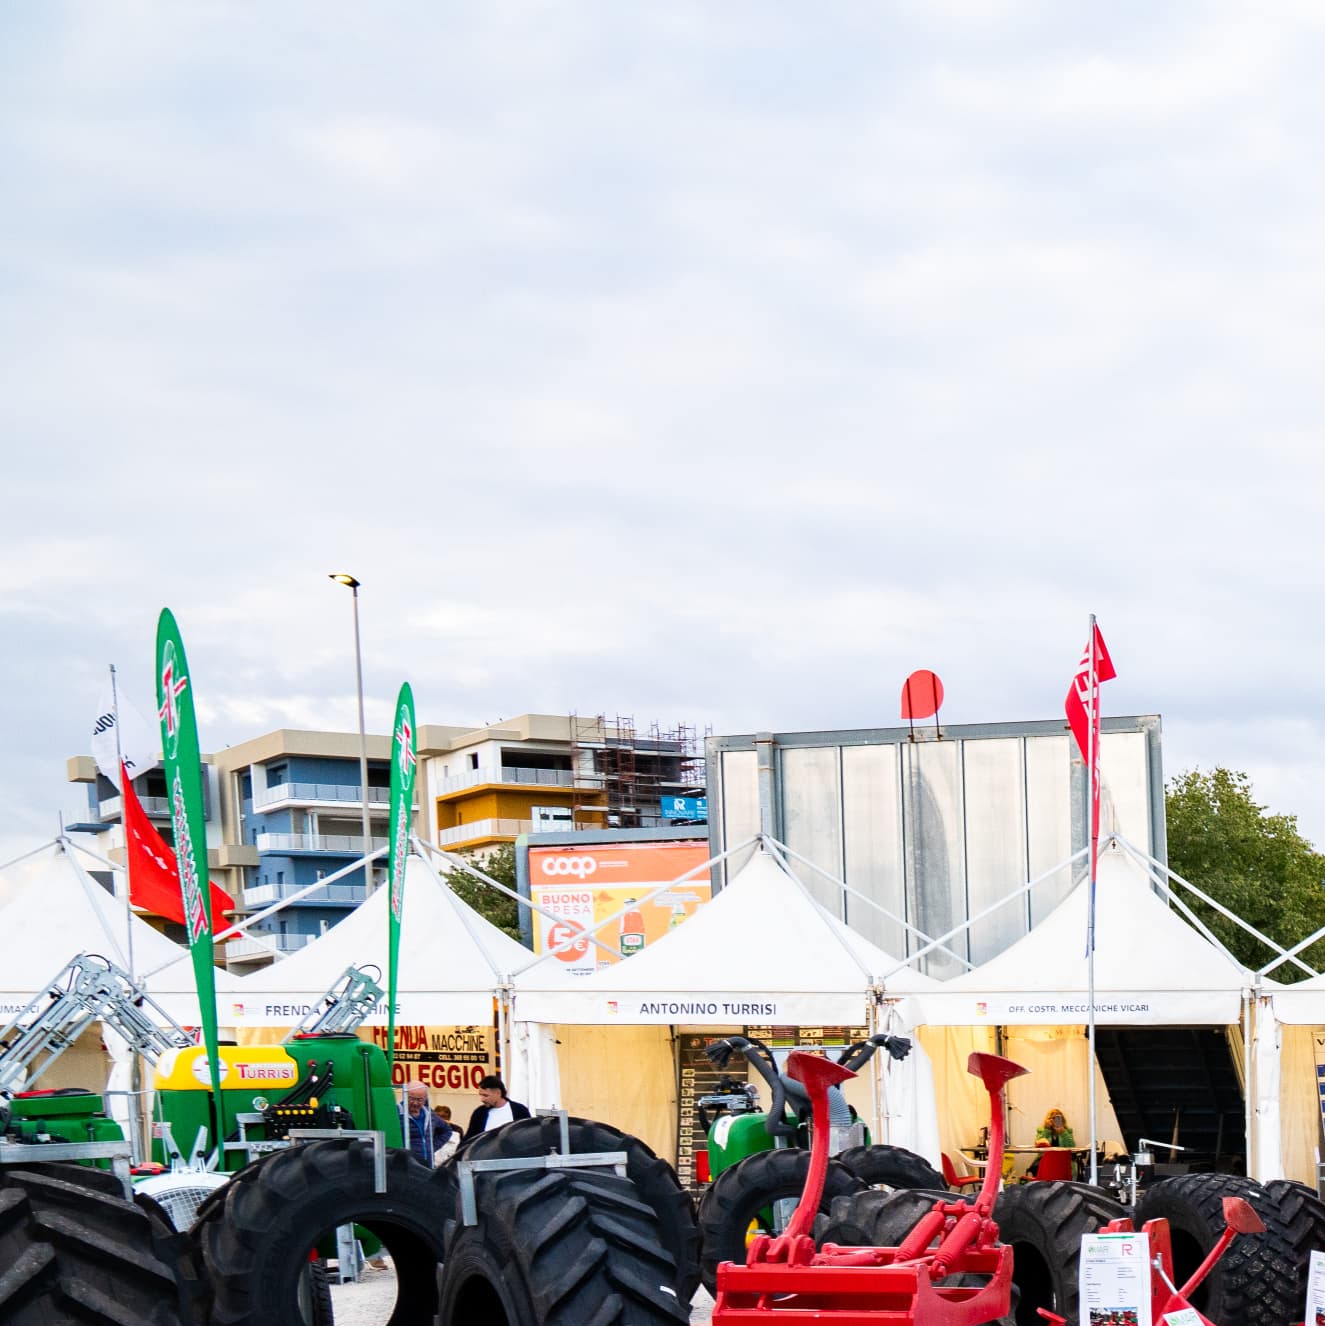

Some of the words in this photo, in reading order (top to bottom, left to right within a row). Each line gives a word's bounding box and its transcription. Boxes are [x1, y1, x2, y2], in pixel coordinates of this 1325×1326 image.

[542, 856, 597, 879] coop
[542, 894, 590, 904] BUONO
[640, 1002, 717, 1015] ANTONINO
[723, 1003, 776, 1015] TURRISI
[1009, 1005, 1026, 1013] OFF.
[1061, 1005, 1118, 1013] MECCANICHE
[1121, 1004, 1149, 1012] VICARI
[431, 1034, 485, 1052] MACCHINE
[391, 1063, 485, 1089] OLEGGIO
